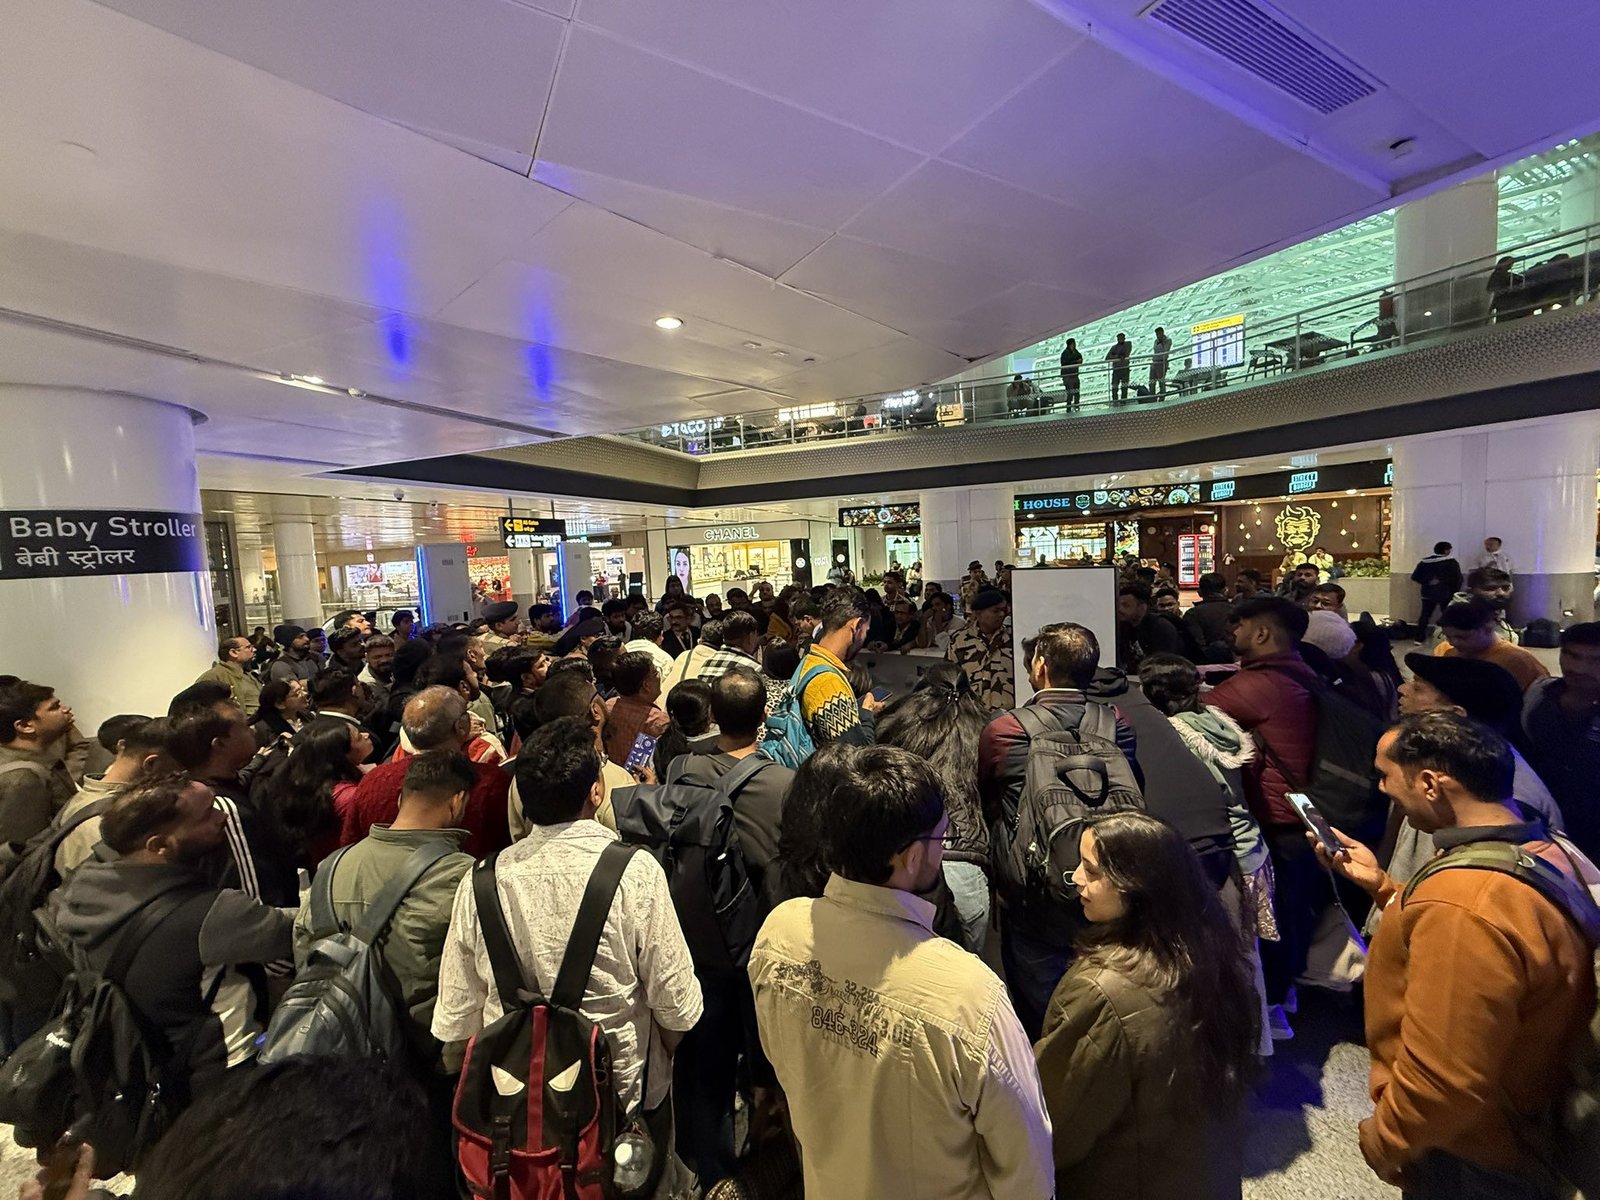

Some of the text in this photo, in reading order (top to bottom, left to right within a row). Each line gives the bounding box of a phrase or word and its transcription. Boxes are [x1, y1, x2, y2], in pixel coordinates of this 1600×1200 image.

[1023, 498, 1071, 510] HOUSE
[9, 516, 196, 542] Baby Stroller
[704, 526, 760, 541] CHANEL
[15, 545, 136, 570] बेबी स्ट्रोलर
